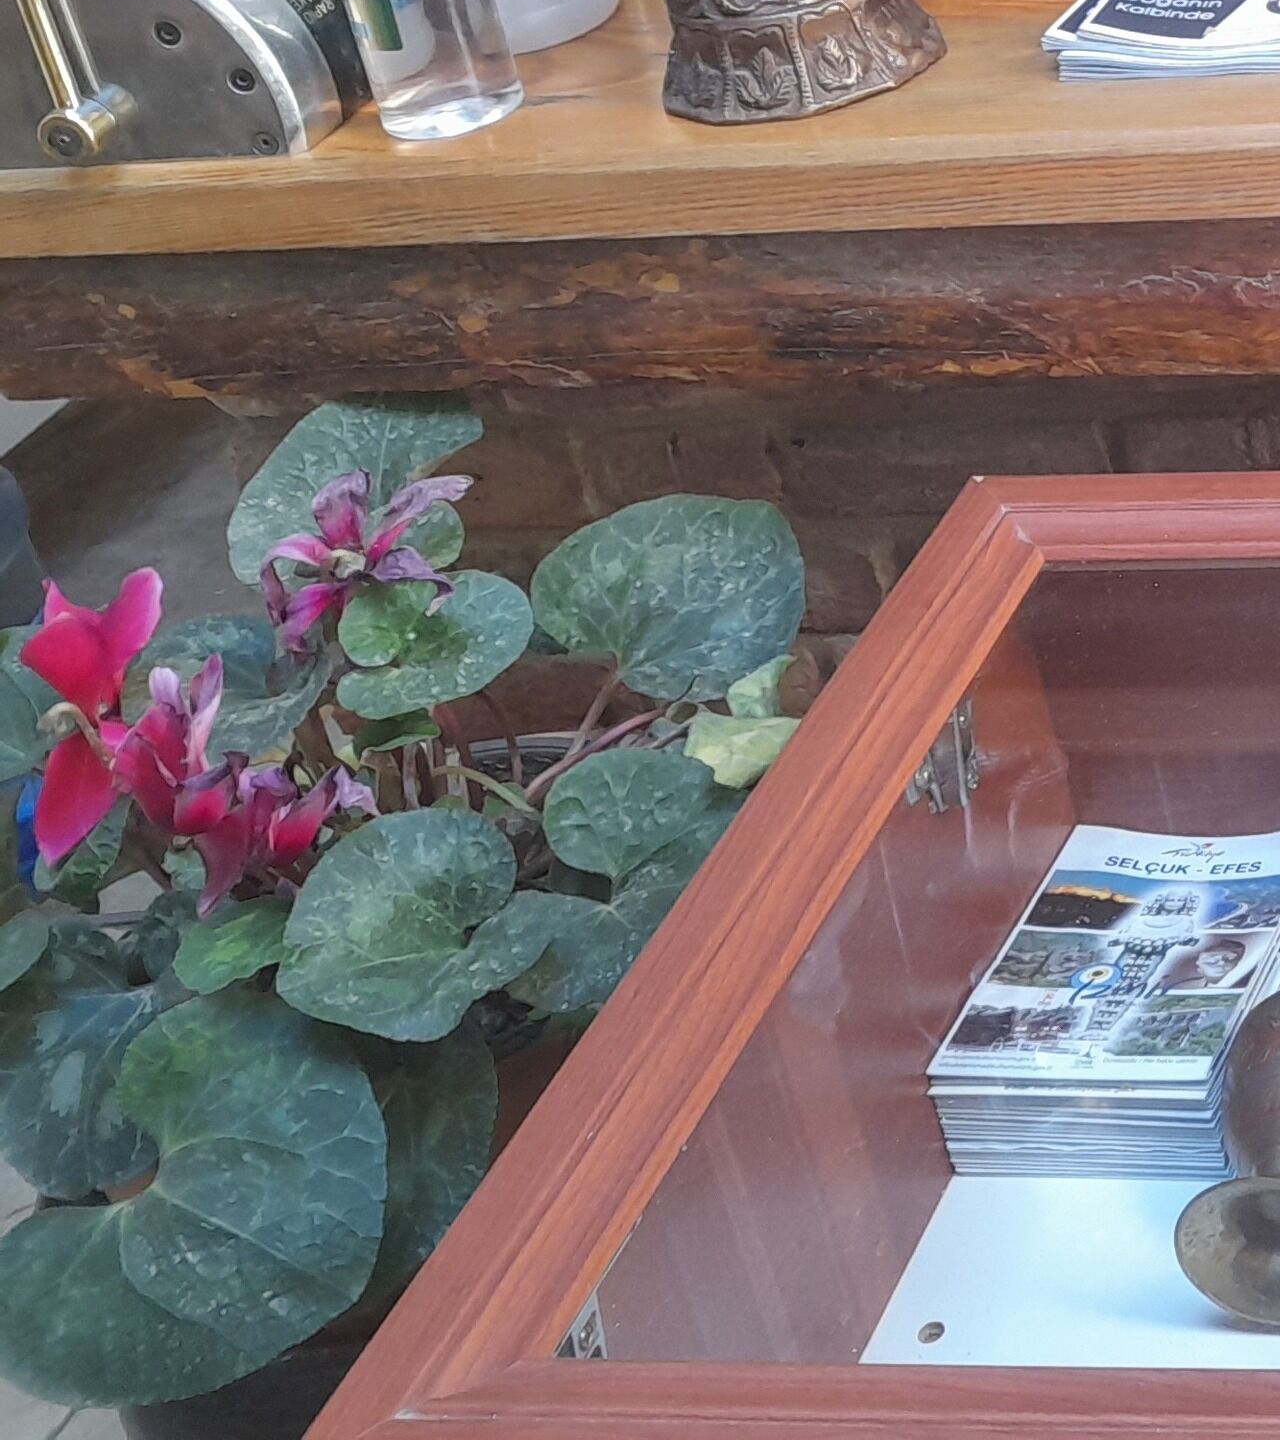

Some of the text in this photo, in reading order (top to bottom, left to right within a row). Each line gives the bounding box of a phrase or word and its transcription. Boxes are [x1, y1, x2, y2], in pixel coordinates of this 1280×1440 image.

[1113, 1, 1216, 21] Kalbinde
[1104, 855, 1191, 876] SELÇUK
[1209, 861, 1263, 876] EFES
